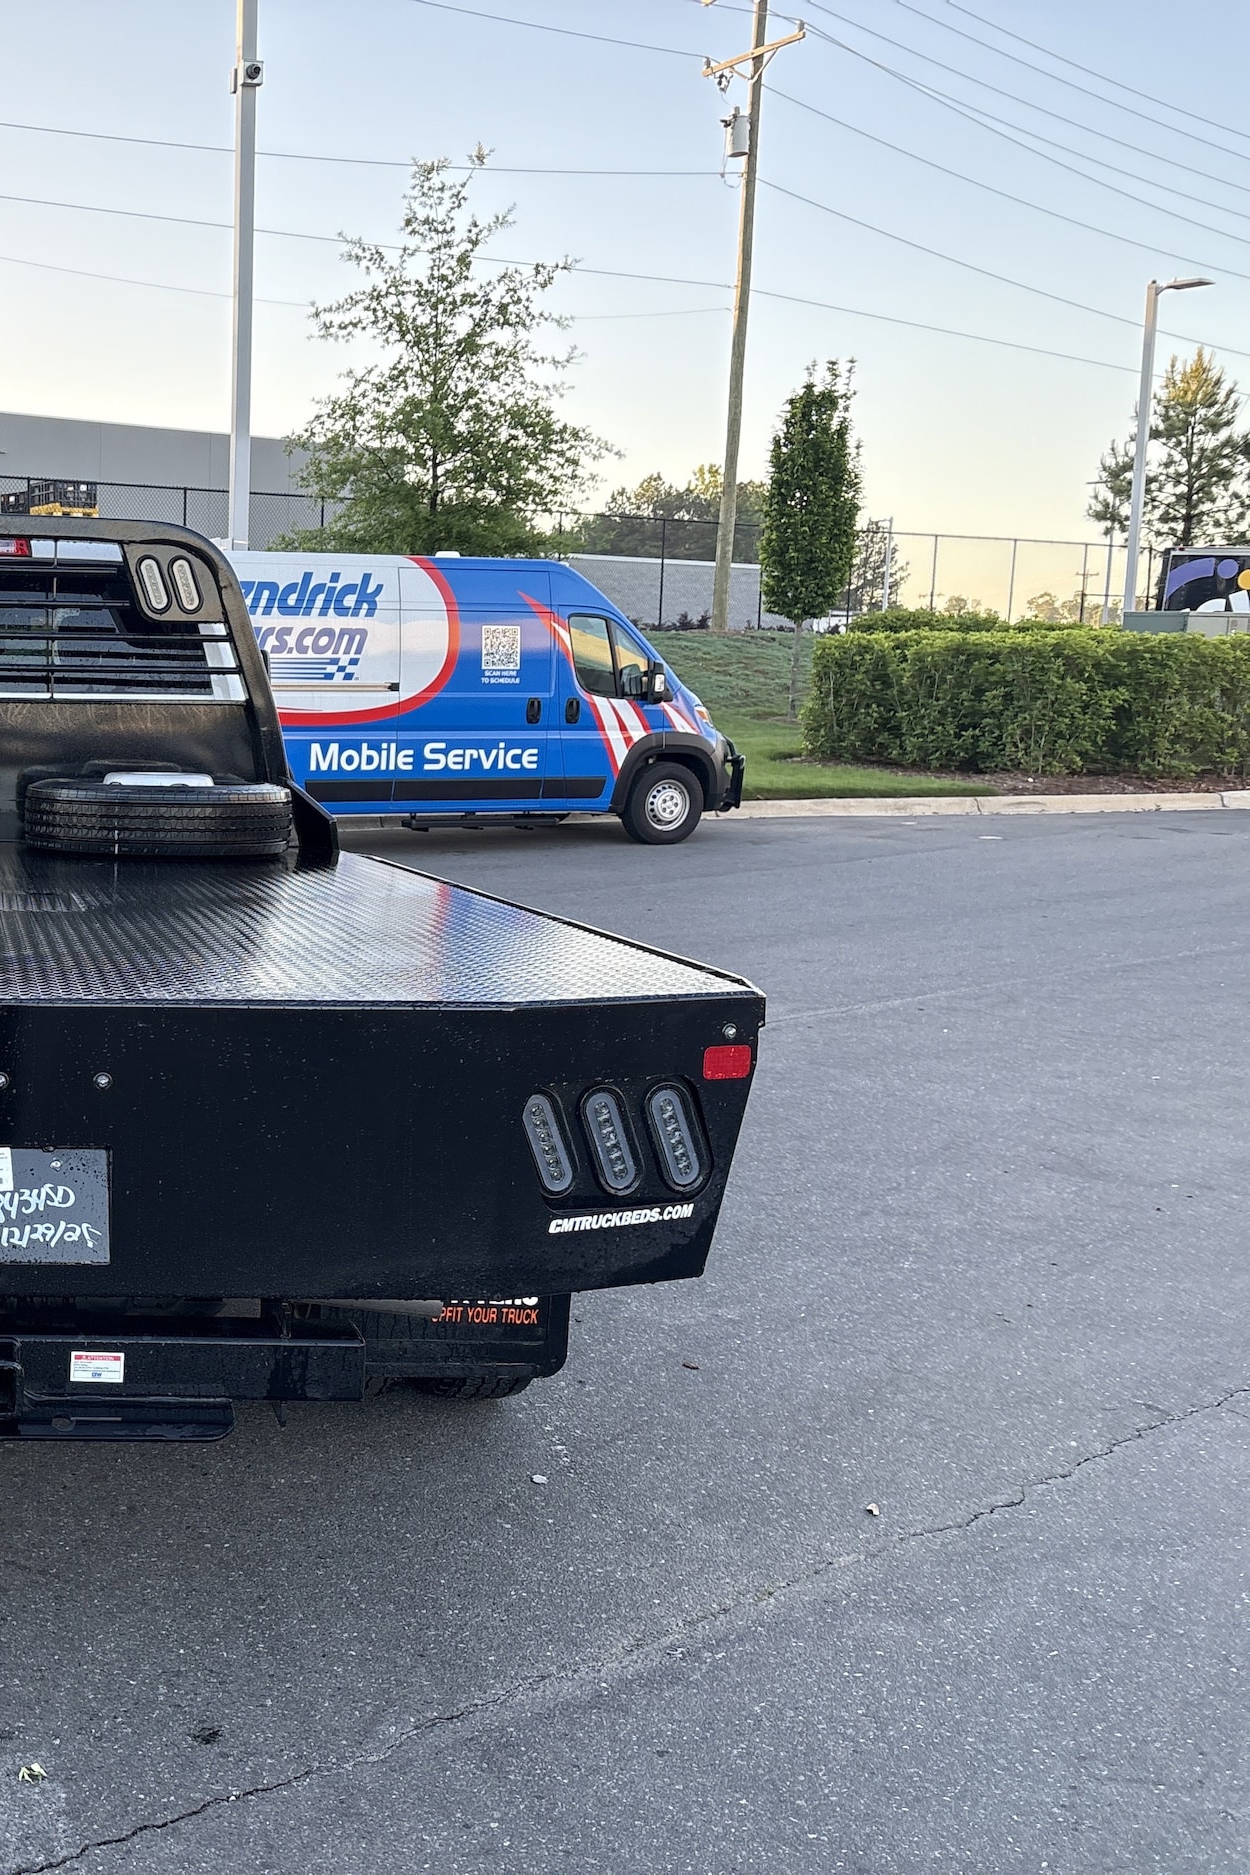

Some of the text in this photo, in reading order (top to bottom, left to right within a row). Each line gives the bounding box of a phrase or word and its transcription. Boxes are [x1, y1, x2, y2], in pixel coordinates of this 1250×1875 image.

[253, 626, 368, 655] rs.com
[309, 742, 538, 771] Mobile Service
[548, 1203, 694, 1233] CMTRUCKBEDS.COM
[432, 1307, 539, 1324] PFIT YOUR TRUCK
